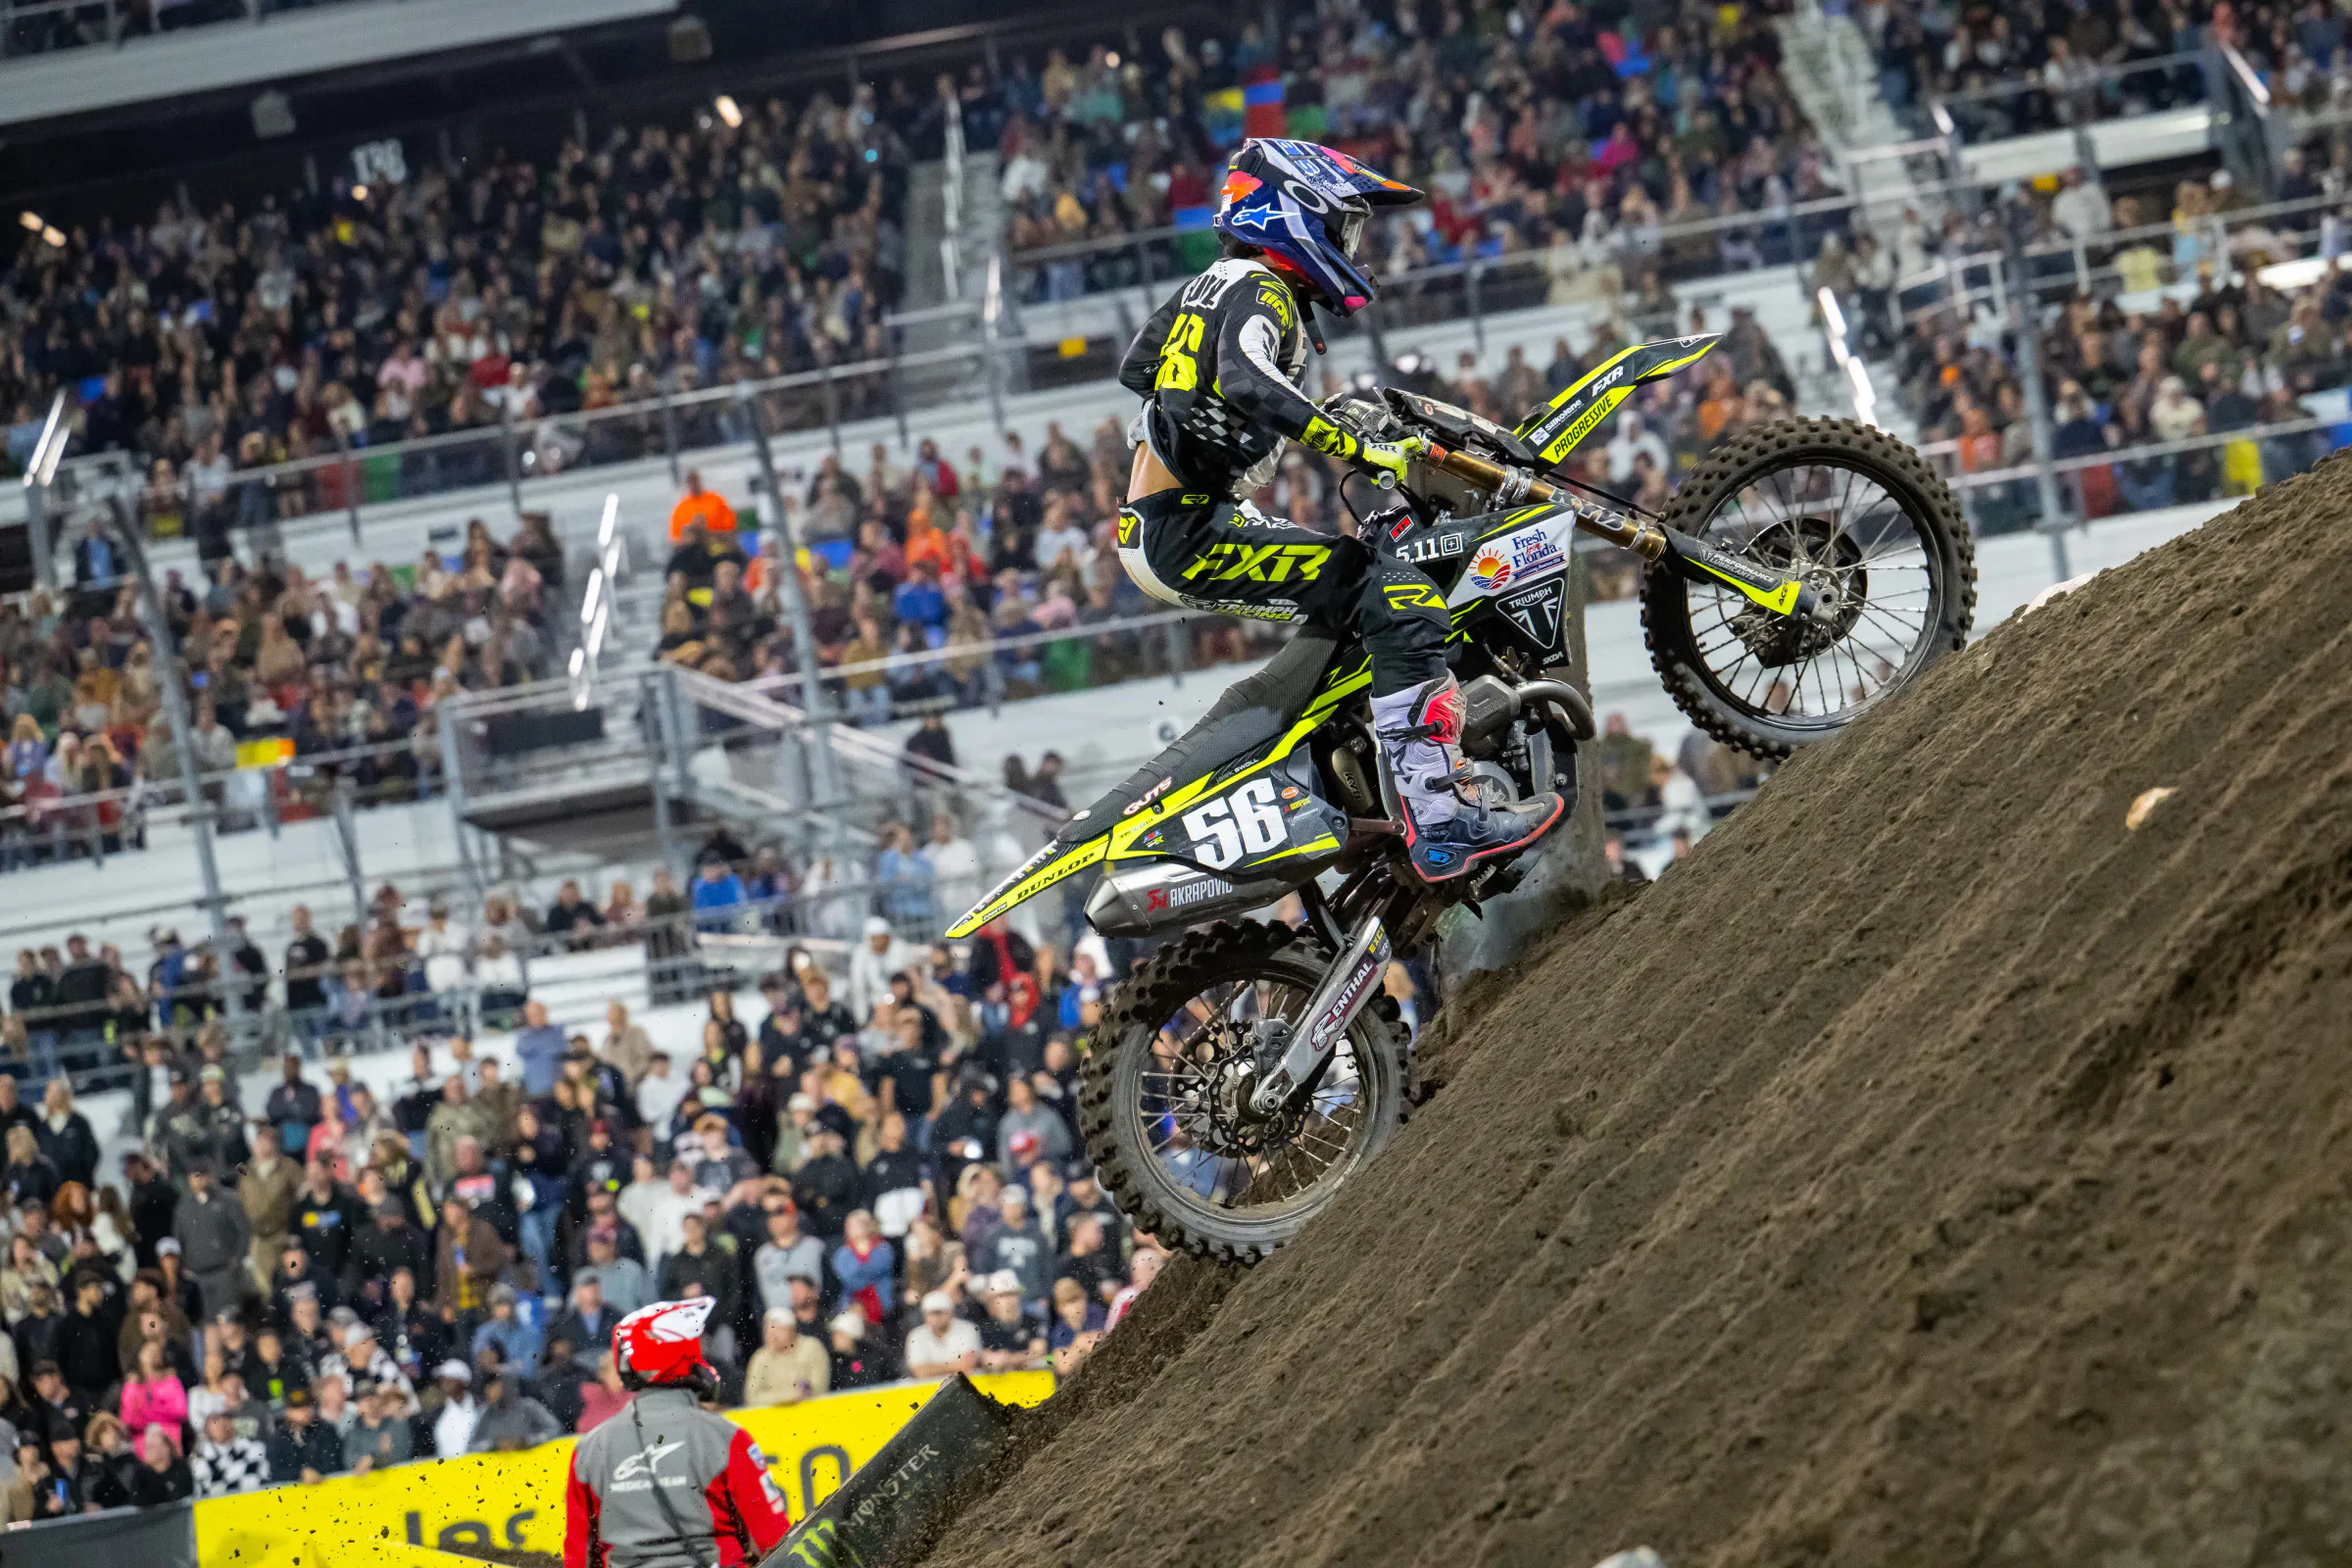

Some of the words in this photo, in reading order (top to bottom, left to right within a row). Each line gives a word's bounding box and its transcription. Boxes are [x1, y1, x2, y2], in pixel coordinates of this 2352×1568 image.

[1592, 366, 1624, 397] FXR
[1553, 394, 1613, 459] PROGRESSIVE
[1396, 538, 1441, 564] 5.11
[1511, 528, 1547, 551] Fresh
[1181, 543, 1332, 582] FXR
[1511, 543, 1558, 568] Florida
[1709, 557, 1755, 580] LUBRICANTS
[1714, 554, 1775, 583] PERFORMANCE
[1217, 604, 1298, 614] TRIUMPH
[1509, 586, 1552, 609] TRIUMPH
[1123, 776, 1173, 816] GUTS
[1182, 777, 1288, 871] 56
[1015, 852, 1095, 901] DUNLOP
